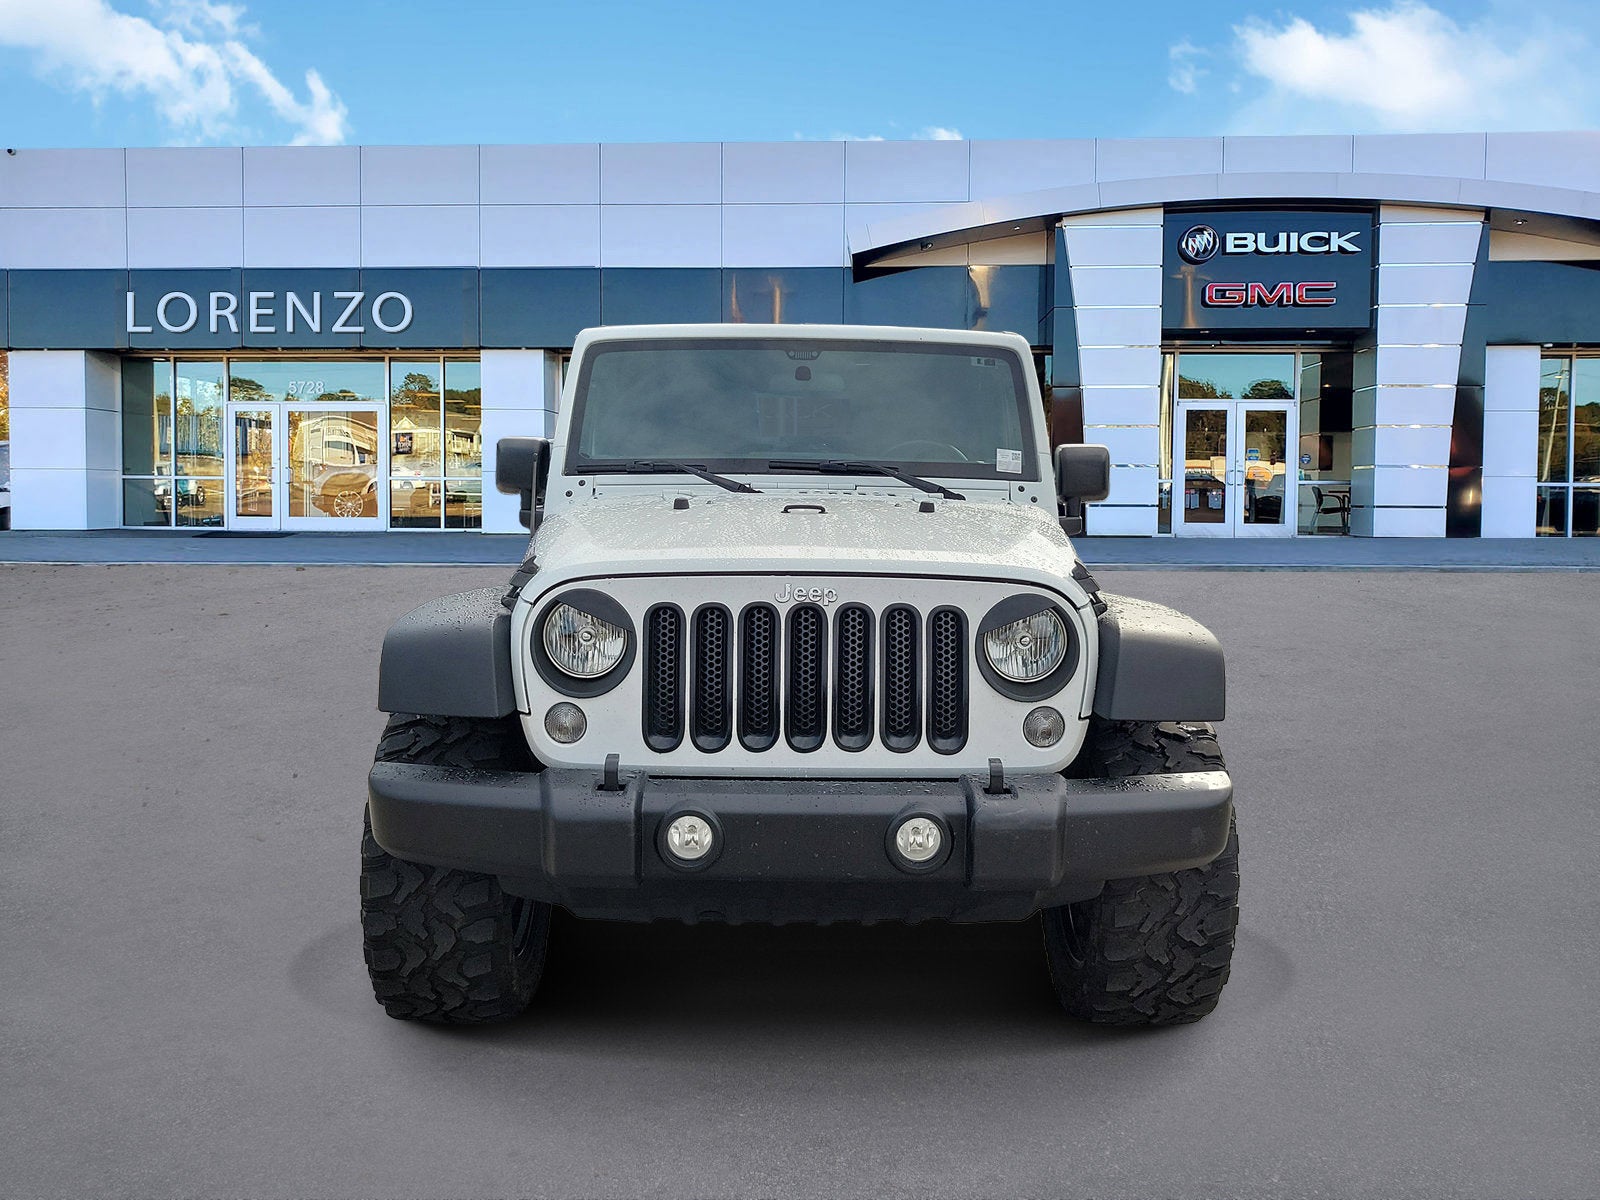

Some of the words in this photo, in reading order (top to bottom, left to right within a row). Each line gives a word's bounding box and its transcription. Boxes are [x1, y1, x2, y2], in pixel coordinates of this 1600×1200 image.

[1225, 231, 1362, 254] BUICK
[1206, 281, 1337, 305] GMC
[126, 291, 414, 334] LORENZO
[288, 380, 325, 395] 5728
[774, 583, 838, 606] Jeep
